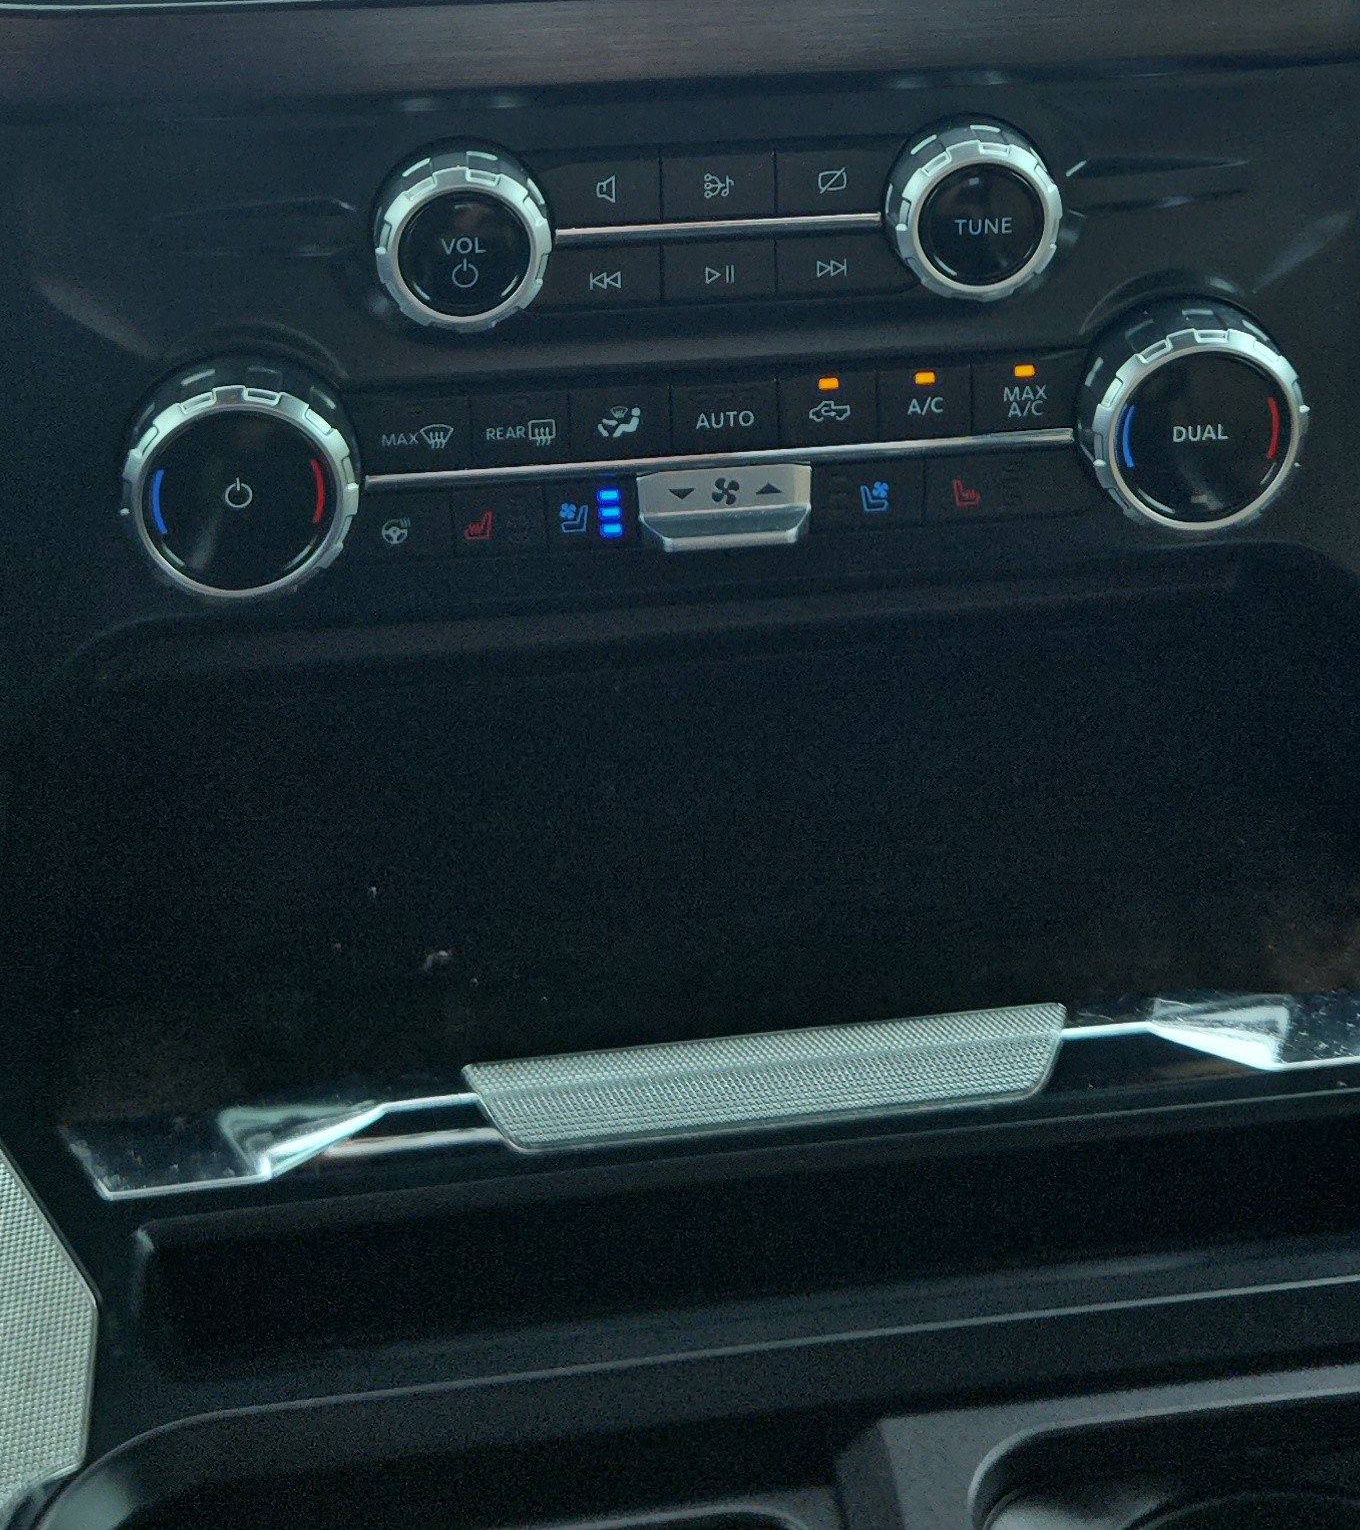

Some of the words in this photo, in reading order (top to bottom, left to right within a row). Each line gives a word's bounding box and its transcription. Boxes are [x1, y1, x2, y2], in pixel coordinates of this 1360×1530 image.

[954, 217, 1013, 237] TUNE
[440, 236, 486, 256] VOL
[1003, 384, 1047, 400] MAX
[907, 395, 945, 417] A/C
[1007, 401, 1044, 418] A/C
[696, 409, 754, 431] AUTO
[380, 431, 418, 449] MAX
[485, 425, 527, 443] REAR
[1172, 423, 1228, 443] DUAL
